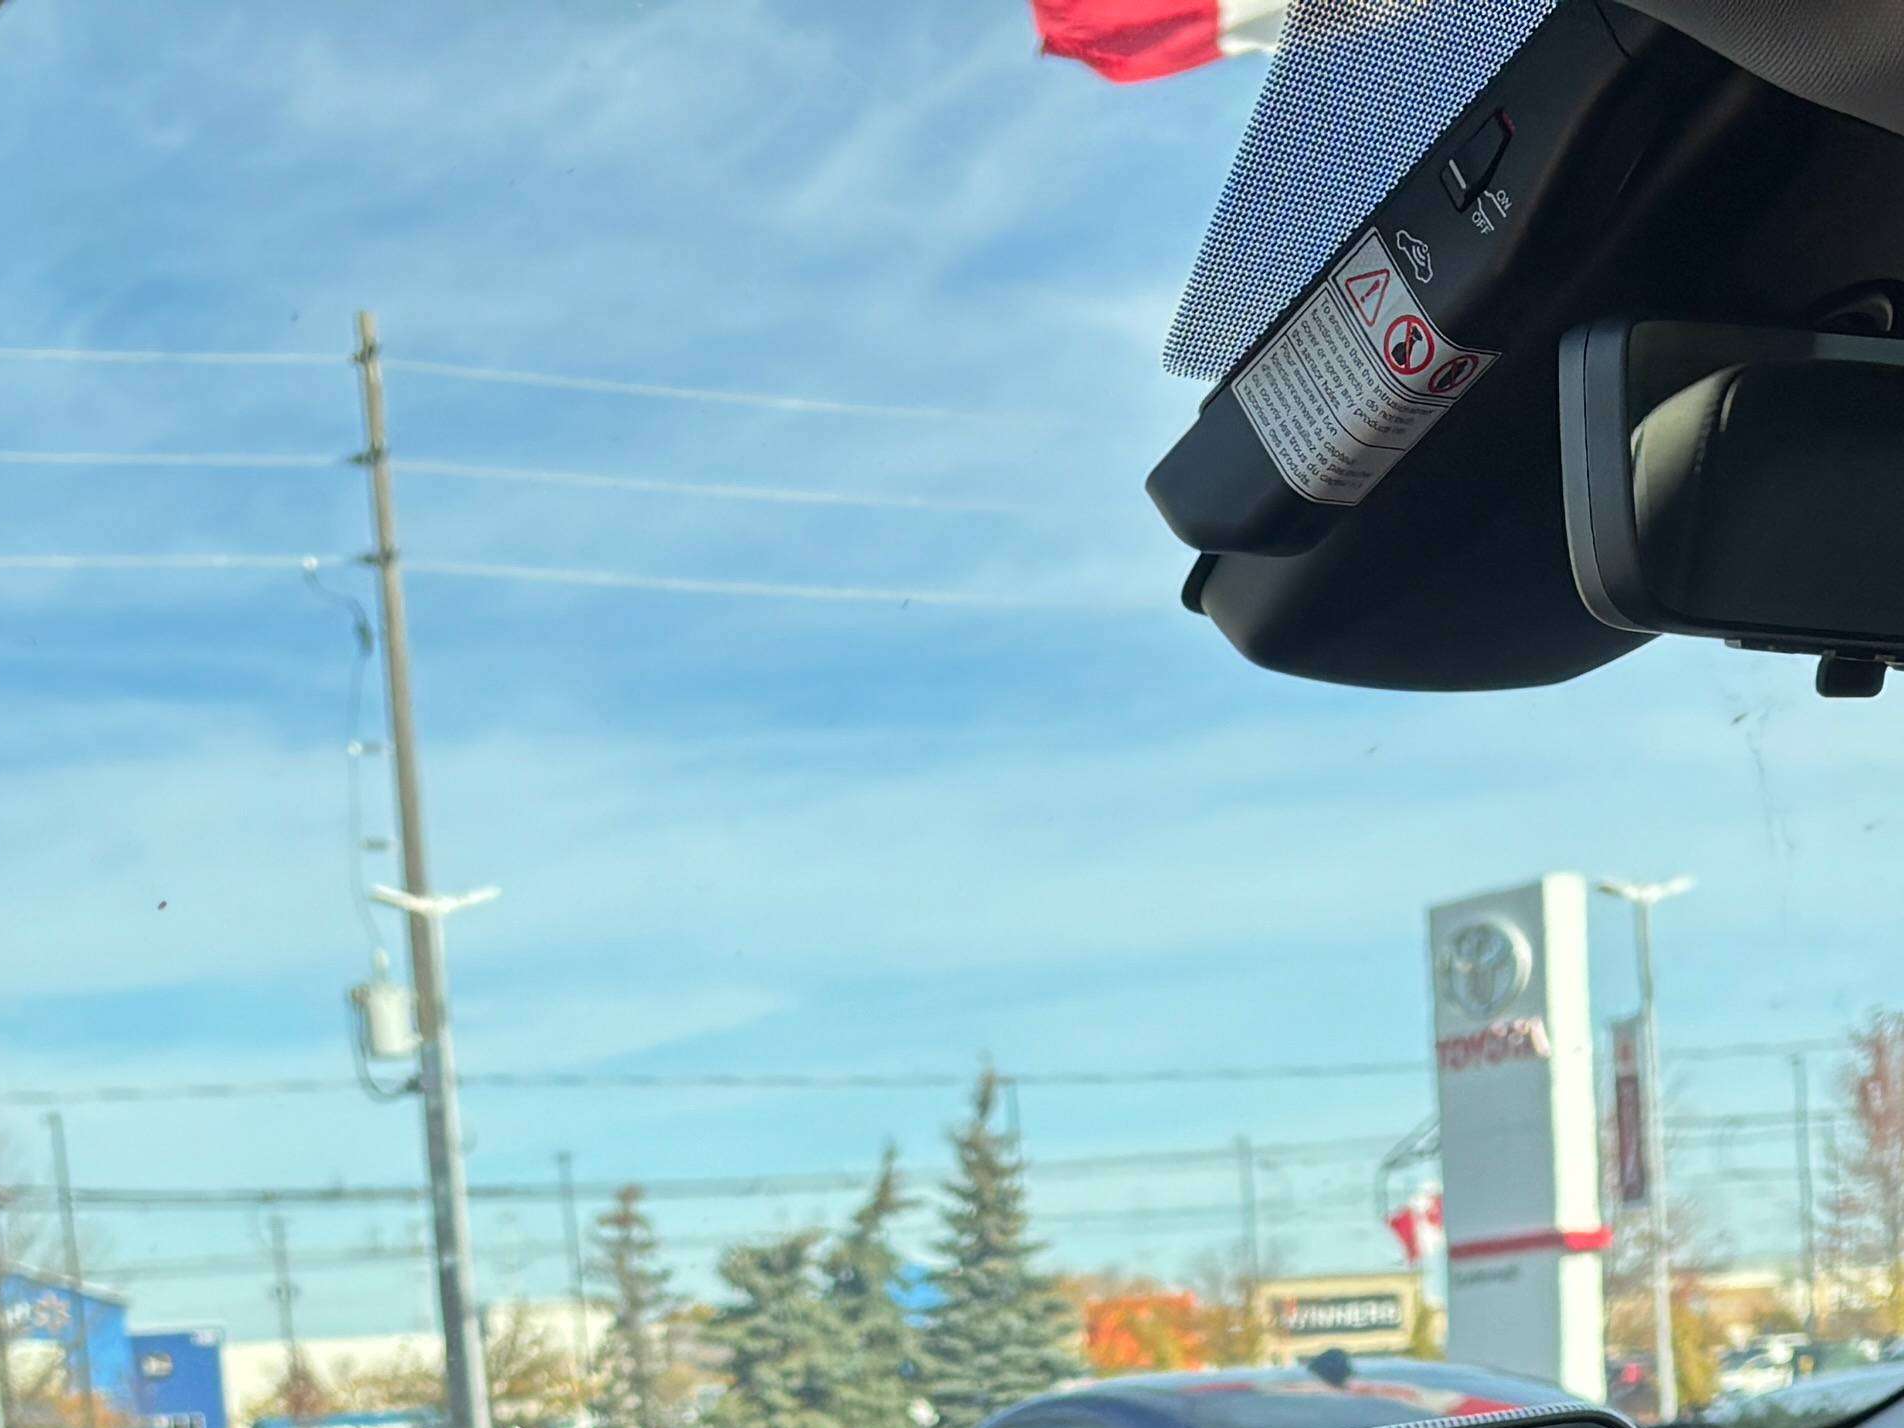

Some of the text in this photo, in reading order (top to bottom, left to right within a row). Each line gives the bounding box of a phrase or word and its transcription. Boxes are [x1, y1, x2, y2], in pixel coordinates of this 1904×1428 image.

[1496, 190, 1513, 211] ON
[1471, 210, 1492, 235] OFF
[1436, 1017, 1550, 1070] TOYOTA
